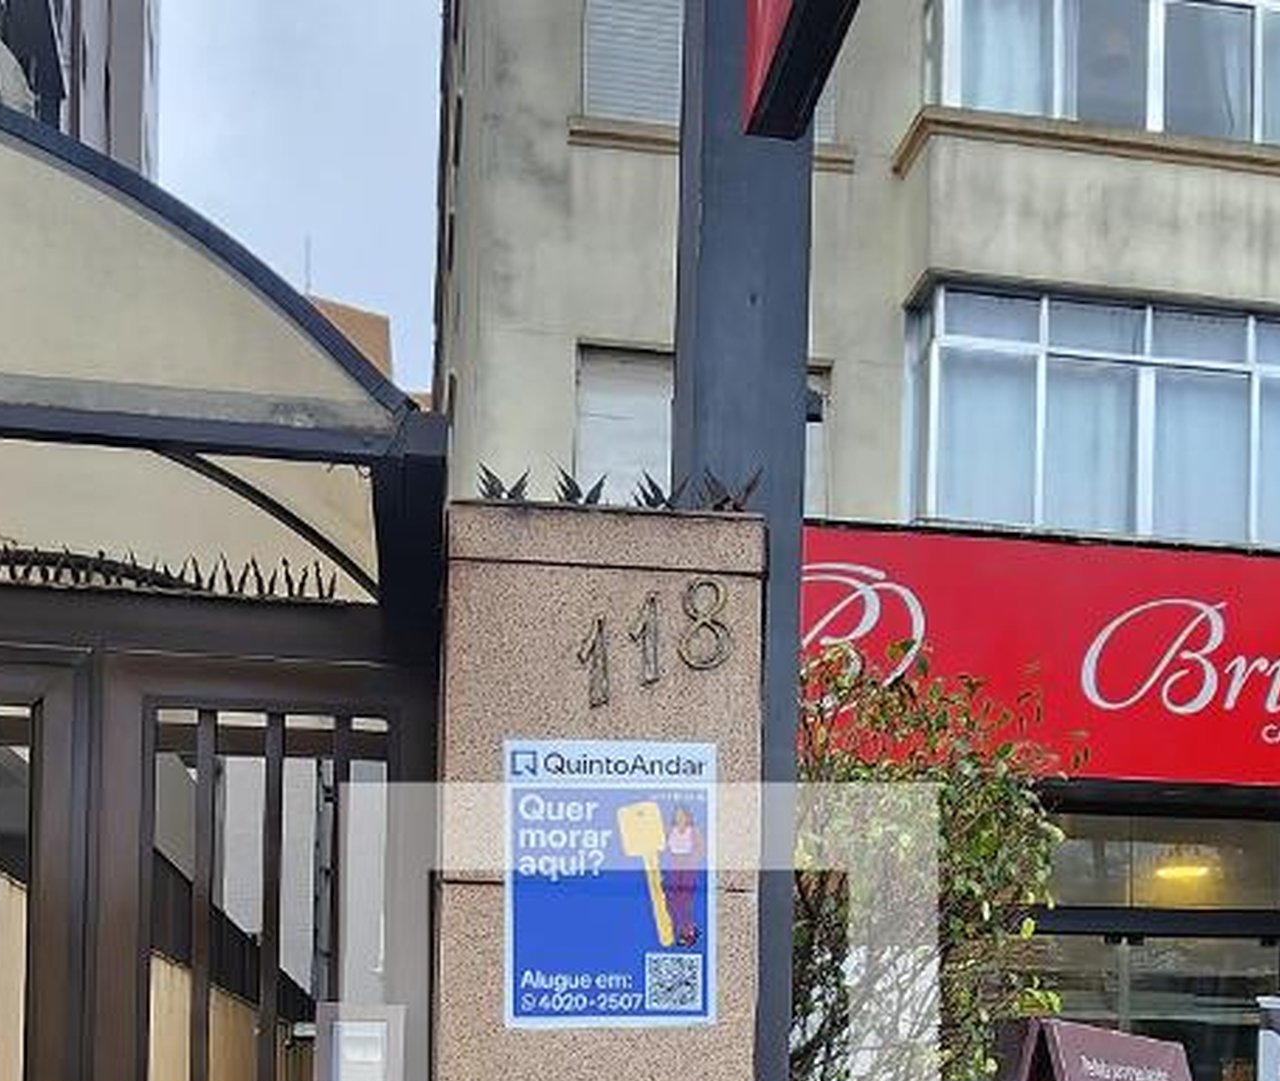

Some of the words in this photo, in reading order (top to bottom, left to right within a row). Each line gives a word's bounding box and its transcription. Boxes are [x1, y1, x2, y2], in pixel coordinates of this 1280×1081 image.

[577, 579, 735, 708] 118
[543, 752, 707, 776] QuintoAndar
[519, 794, 600, 821] Quer
[519, 828, 613, 849] morar
[519, 850, 605, 880] aqui?
[521, 970, 592, 992] Alugue
[595, 972, 634, 990] em:
[538, 993, 643, 1011] 4020-2507
